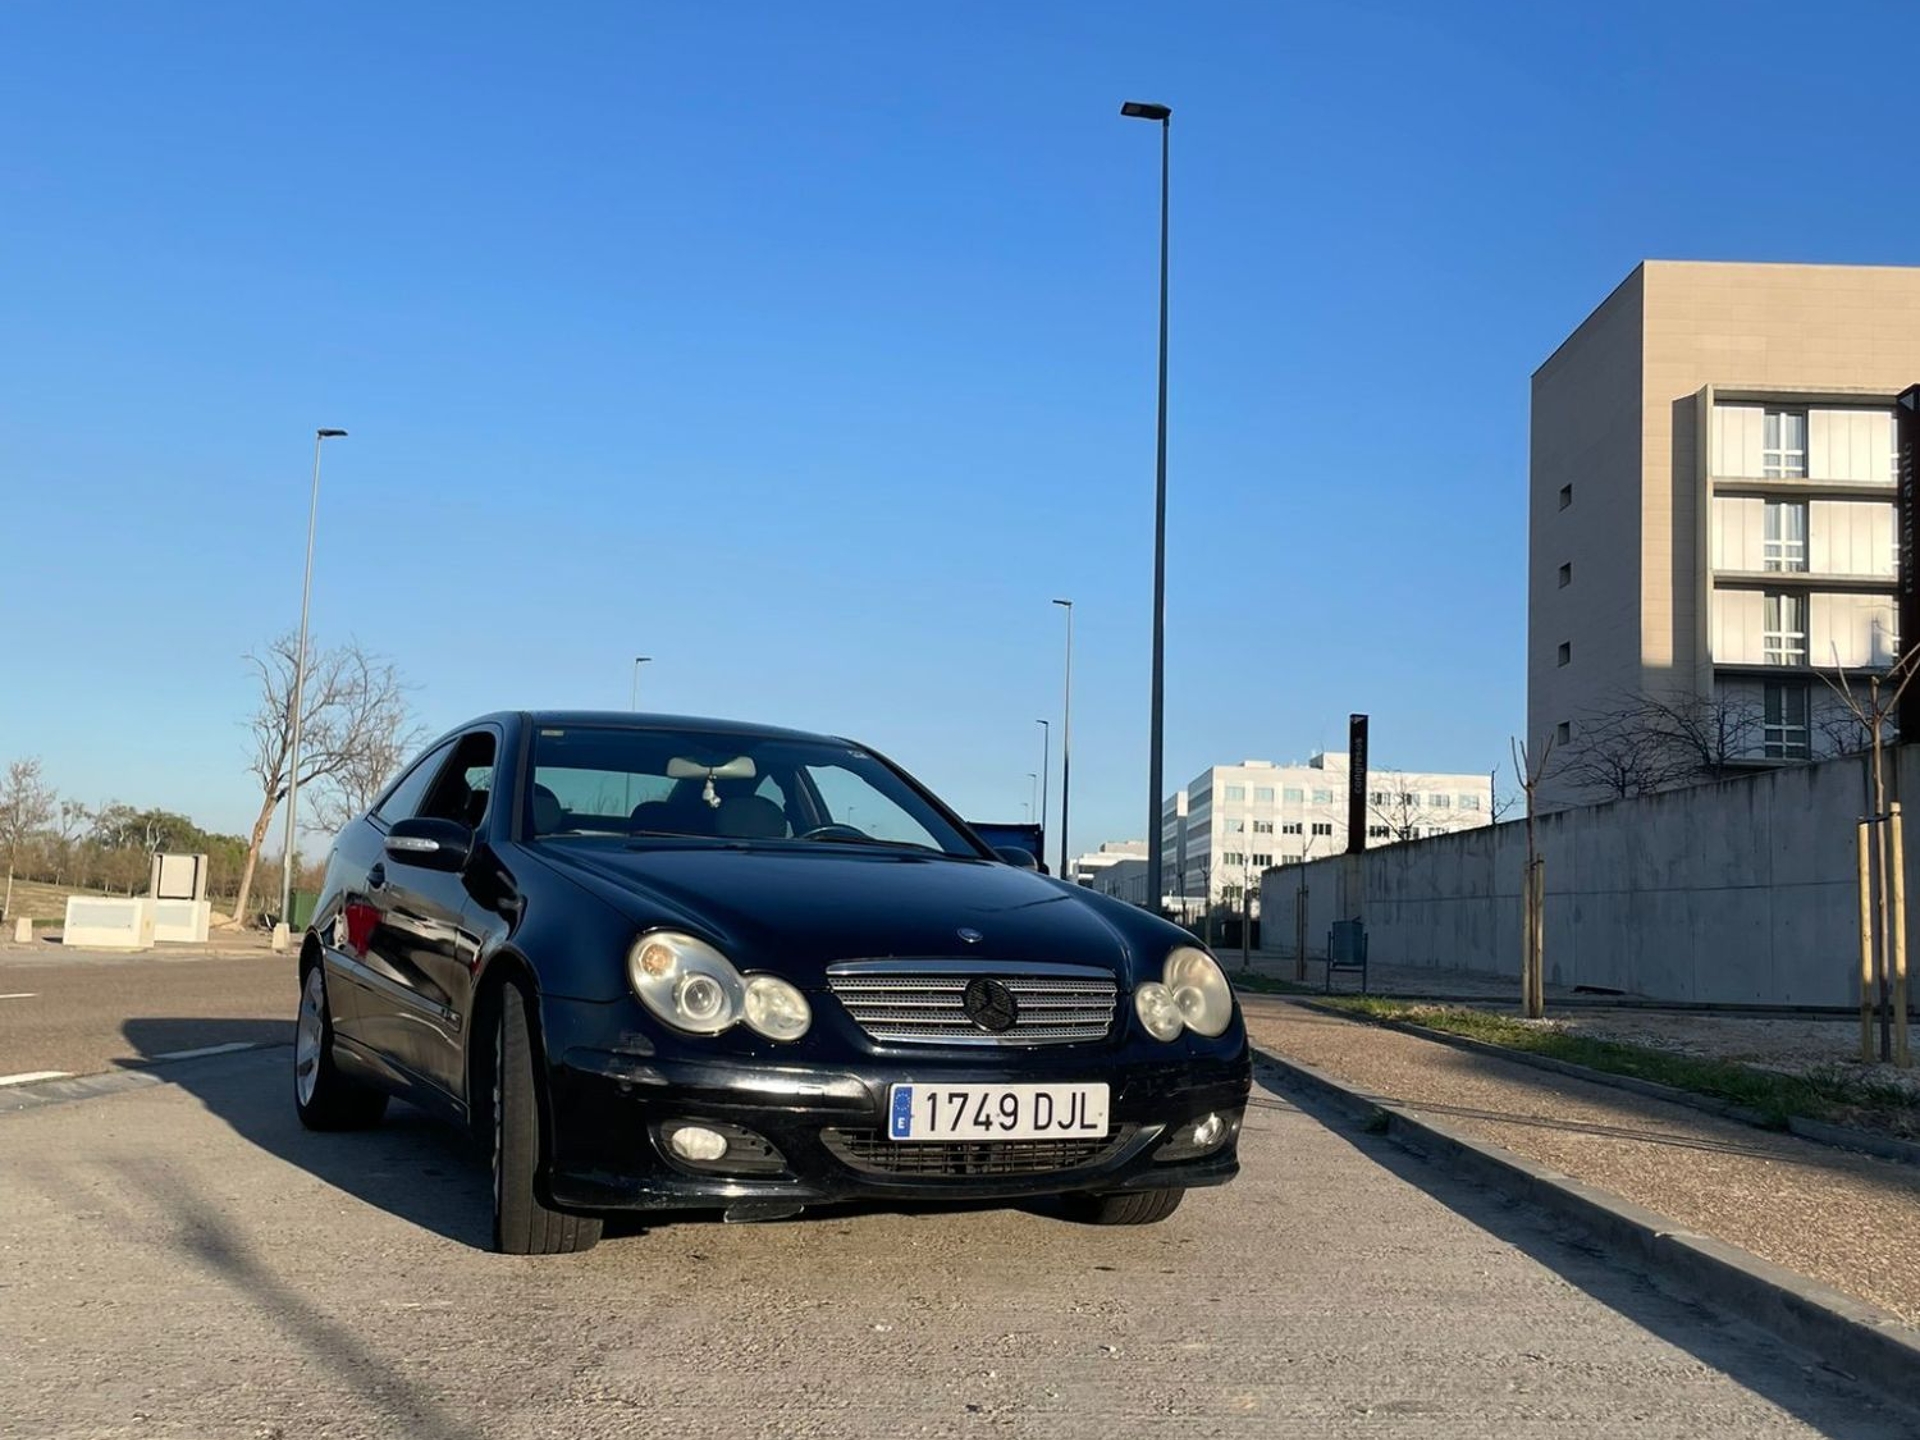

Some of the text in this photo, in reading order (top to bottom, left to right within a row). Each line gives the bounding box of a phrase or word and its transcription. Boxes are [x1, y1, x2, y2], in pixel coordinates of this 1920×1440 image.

[1353, 737, 1364, 794] congresos
[897, 1117, 905, 1129] E
[926, 1091, 1098, 1132] 1749 DJL
